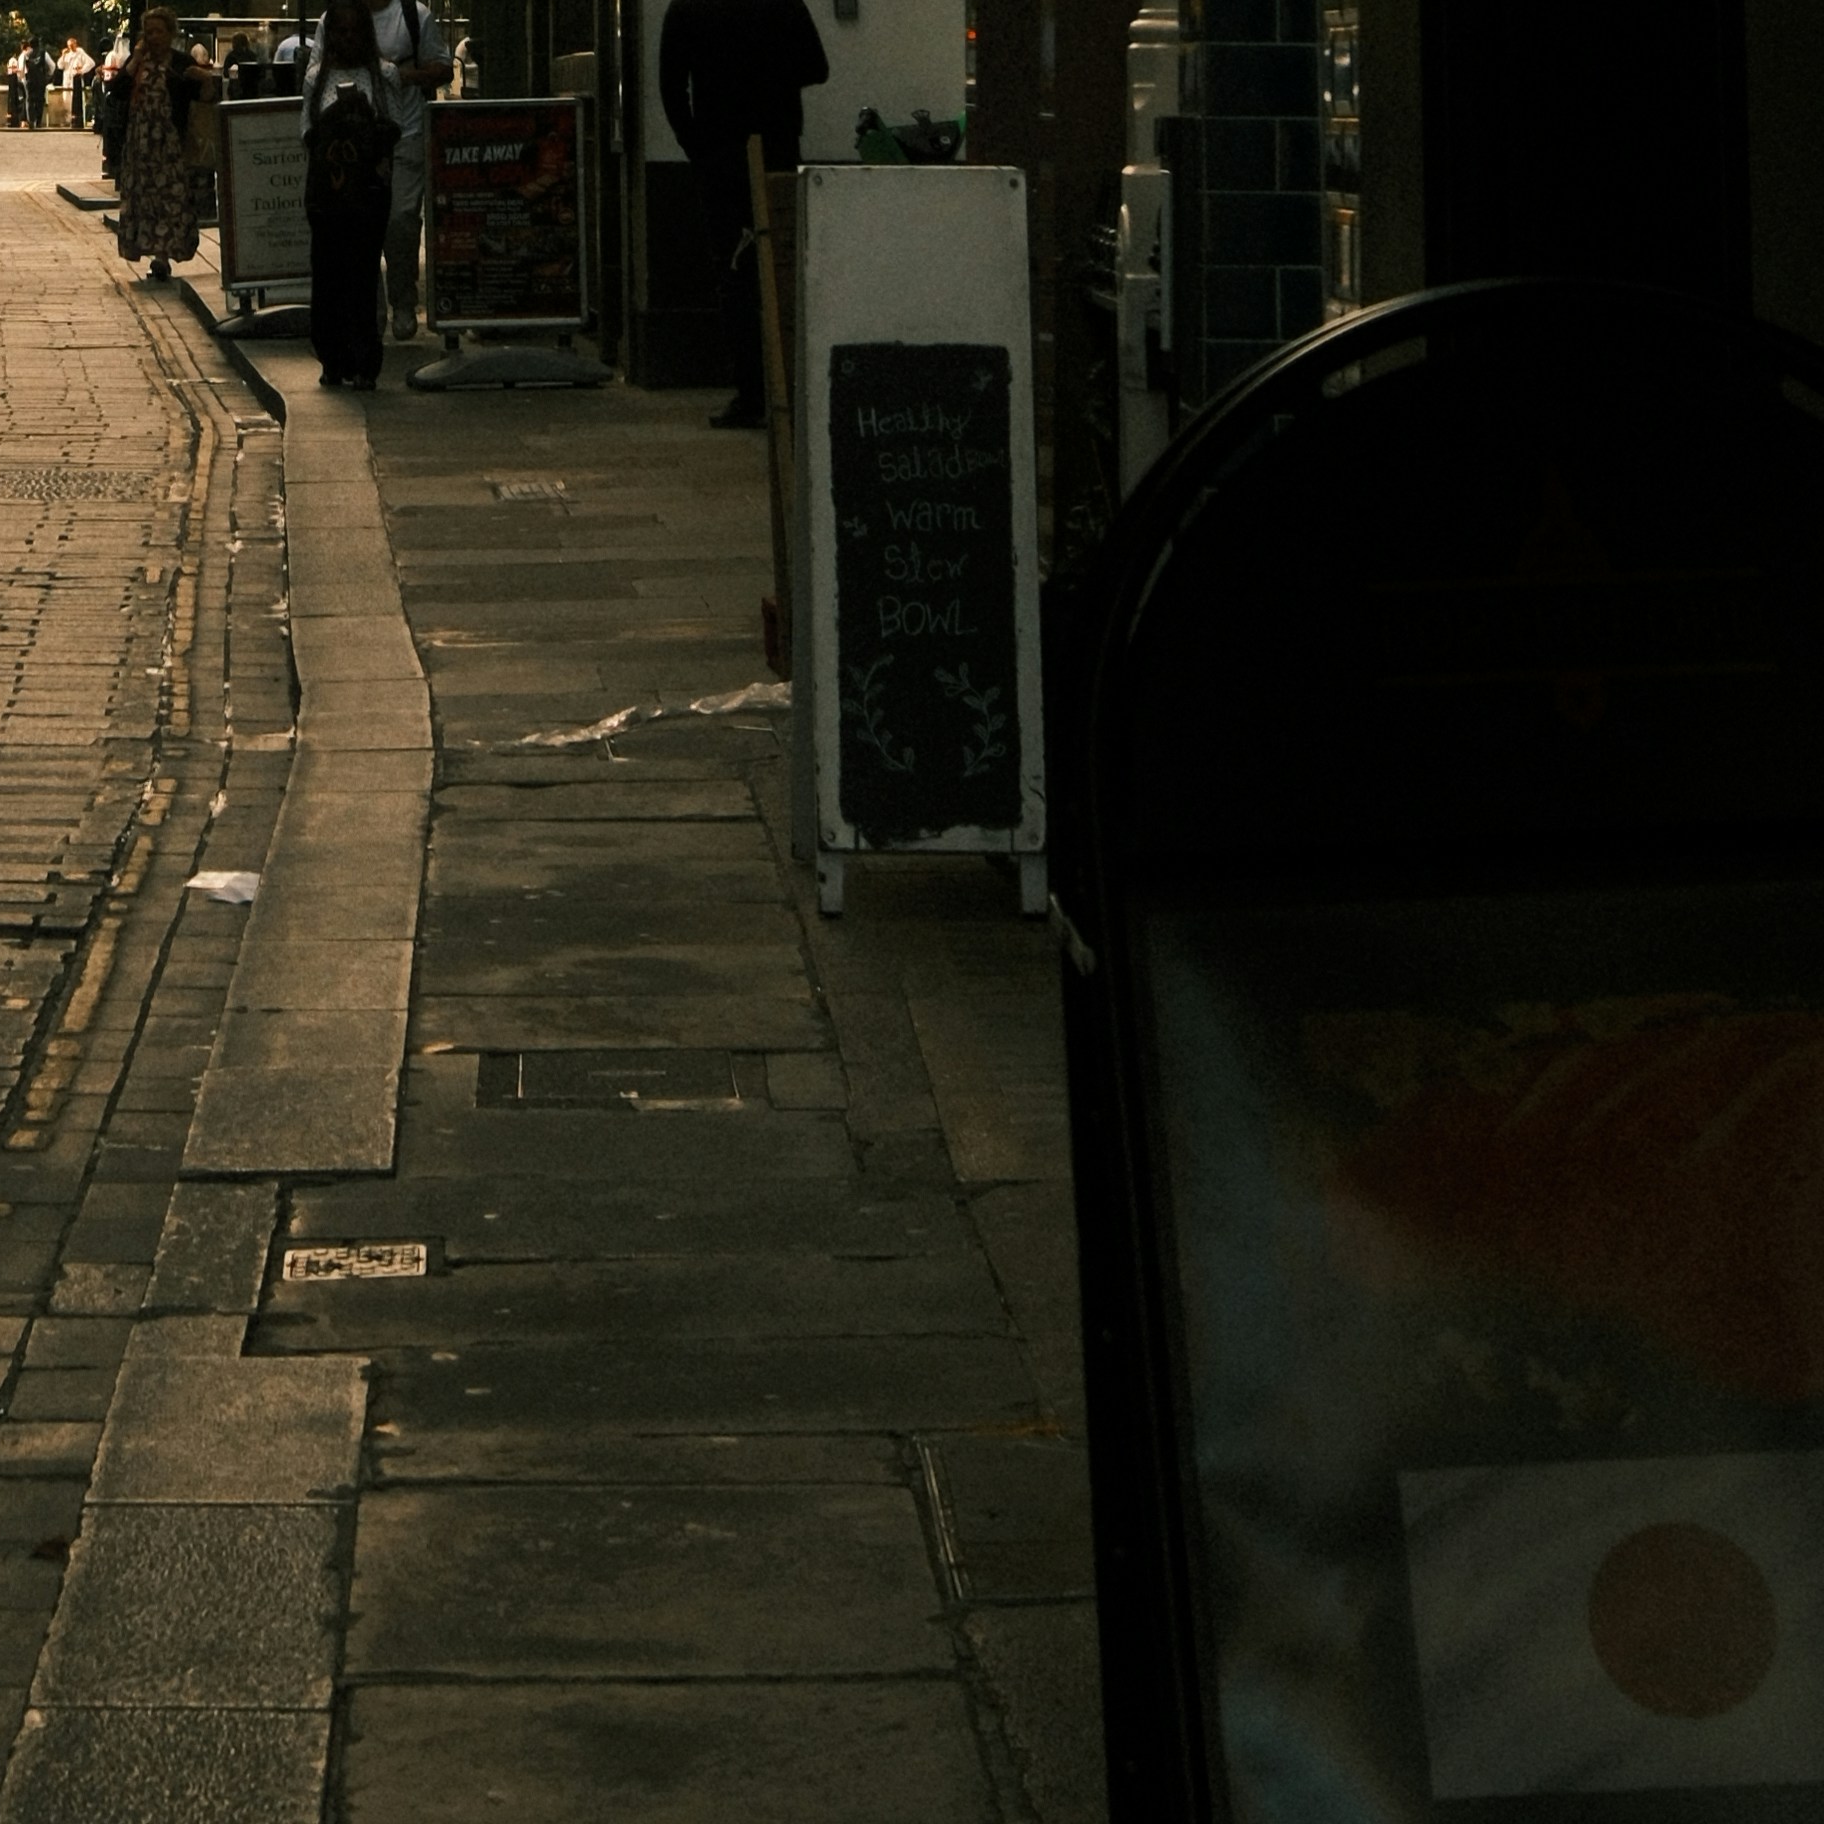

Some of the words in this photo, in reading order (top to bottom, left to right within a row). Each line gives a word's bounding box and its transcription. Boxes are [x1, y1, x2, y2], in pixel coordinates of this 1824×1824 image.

[444, 146, 481, 165] TAKE
[482, 142, 524, 163] AWAY
[269, 173, 303, 189] City
[856, 402, 972, 440] Healthy
[878, 445, 962, 483] Salad
[883, 540, 969, 583] Stew
[877, 594, 979, 639] BOWL
